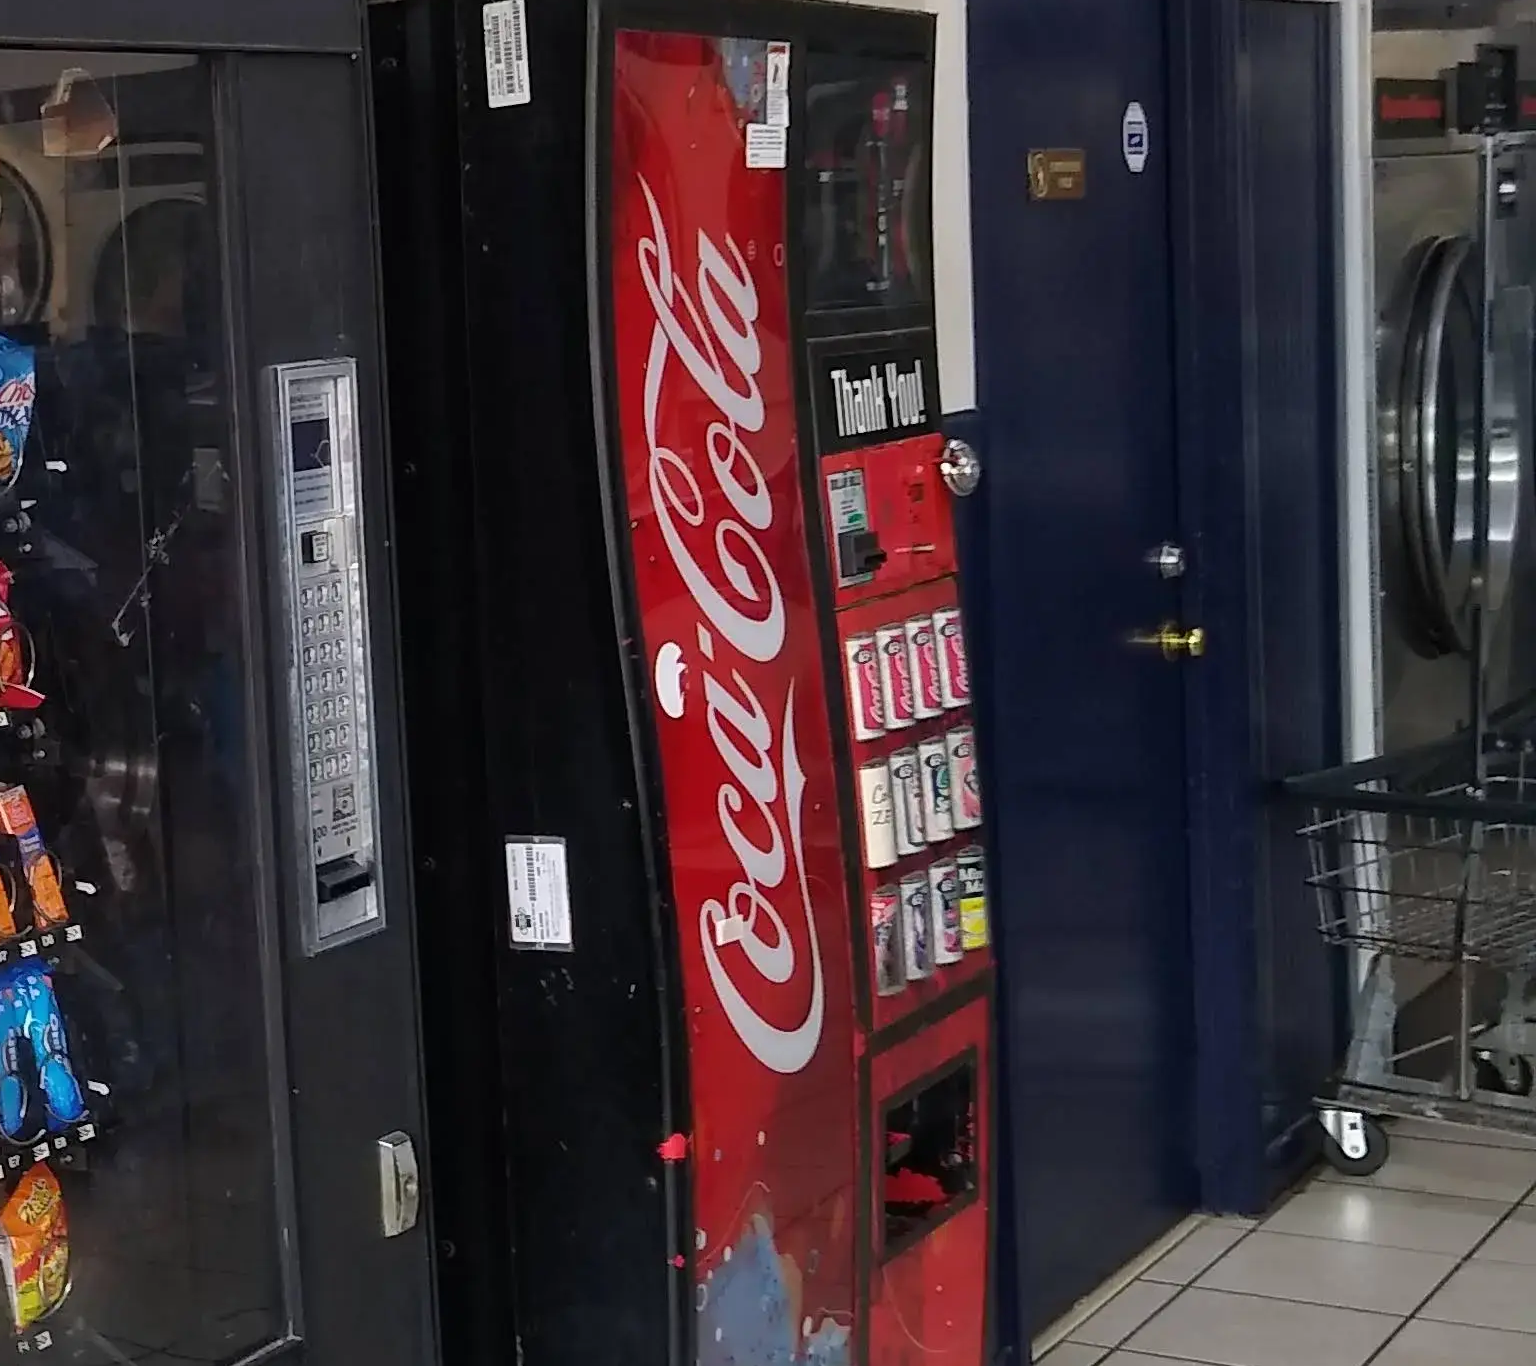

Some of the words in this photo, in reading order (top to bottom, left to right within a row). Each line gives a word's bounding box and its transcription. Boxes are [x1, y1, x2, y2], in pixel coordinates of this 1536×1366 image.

[638, 173, 825, 1074] Coca-Cola
[831, 365, 888, 436] Thank
[886, 359, 927, 428] You!
